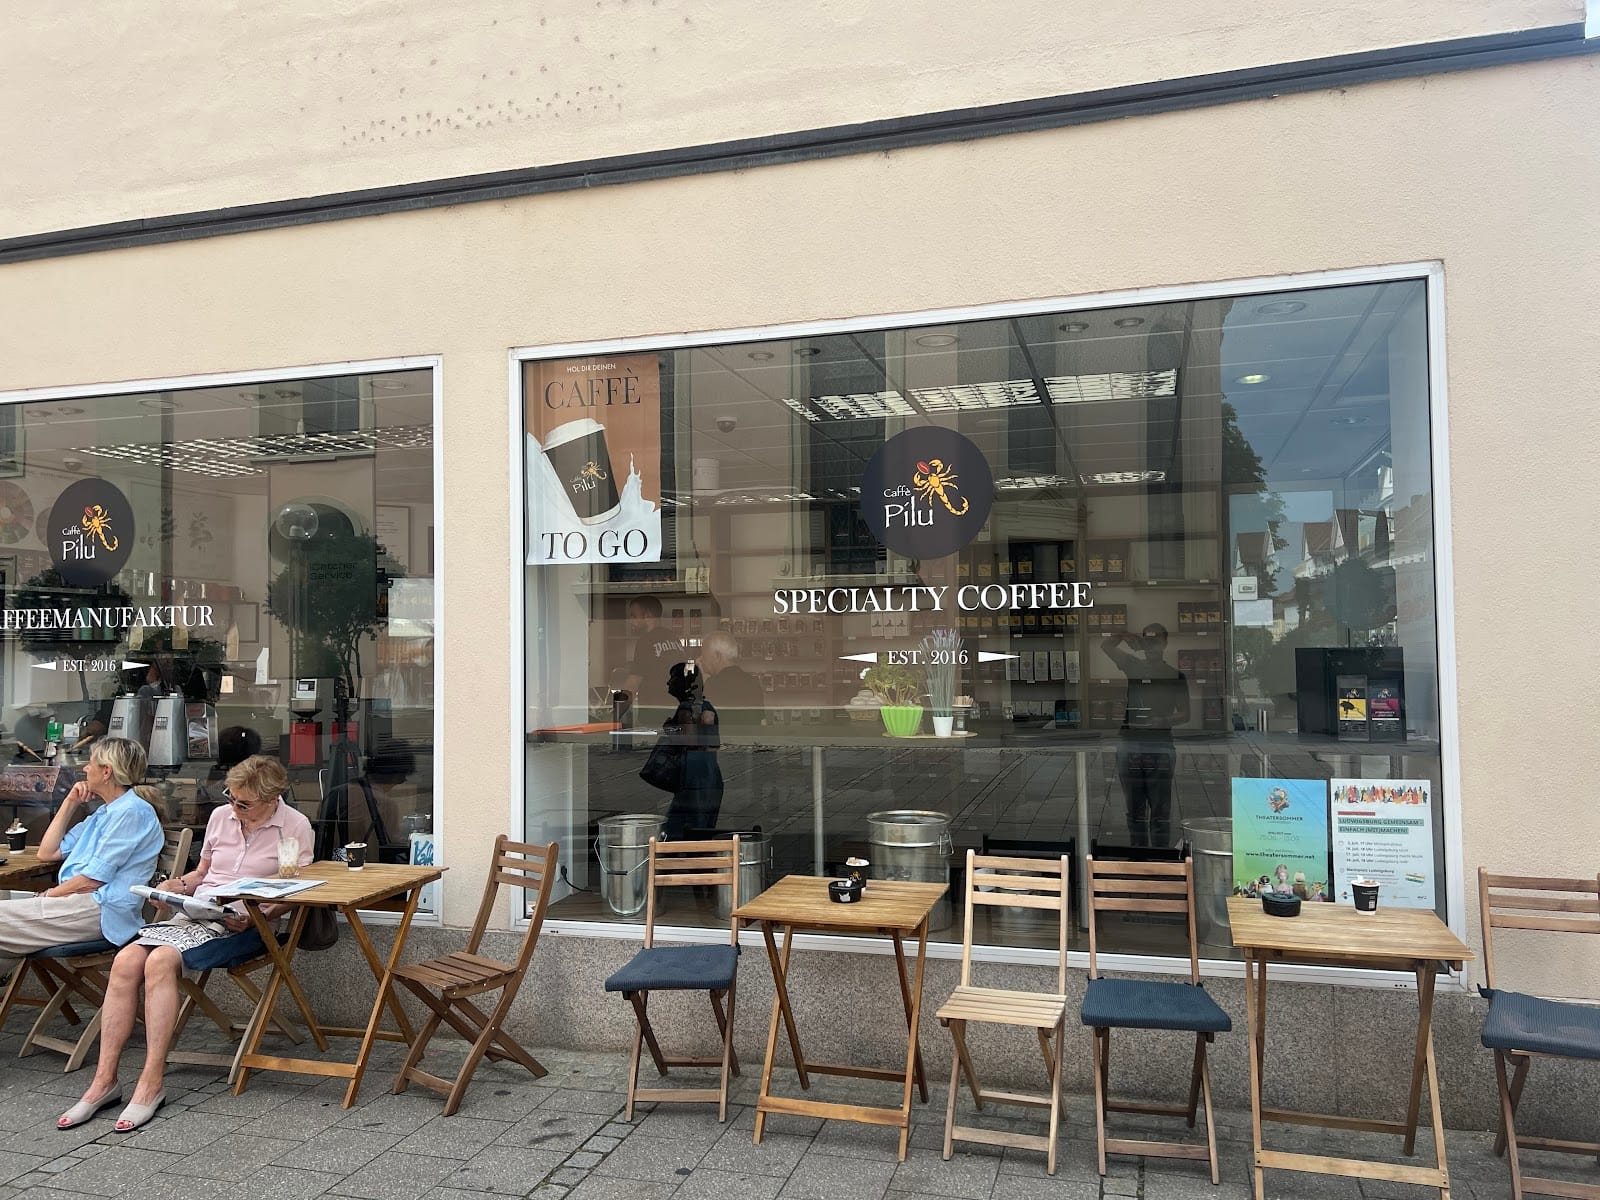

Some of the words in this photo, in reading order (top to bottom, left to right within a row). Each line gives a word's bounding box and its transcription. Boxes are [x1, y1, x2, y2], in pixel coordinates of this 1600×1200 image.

[581, 364, 591, 372] DIR
[592, 363, 616, 371] DEINEN
[544, 367, 641, 410] CAFFÈ
[883, 485, 912, 498] Caffè
[884, 496, 934, 528] Pilu
[62, 533, 96, 561] Pilu
[541, 531, 588, 560] TO
[598, 528, 648, 559] GO
[773, 585, 949, 614] SPECIALTY
[957, 581, 1095, 611] COFFEE
[0, 605, 215, 630] FFEEMANUFAKTUR
[63, 660, 88, 672] EST.
[91, 659, 116, 672] 2016
[887, 650, 926, 665] EST.
[930, 650, 969, 665] 2016
